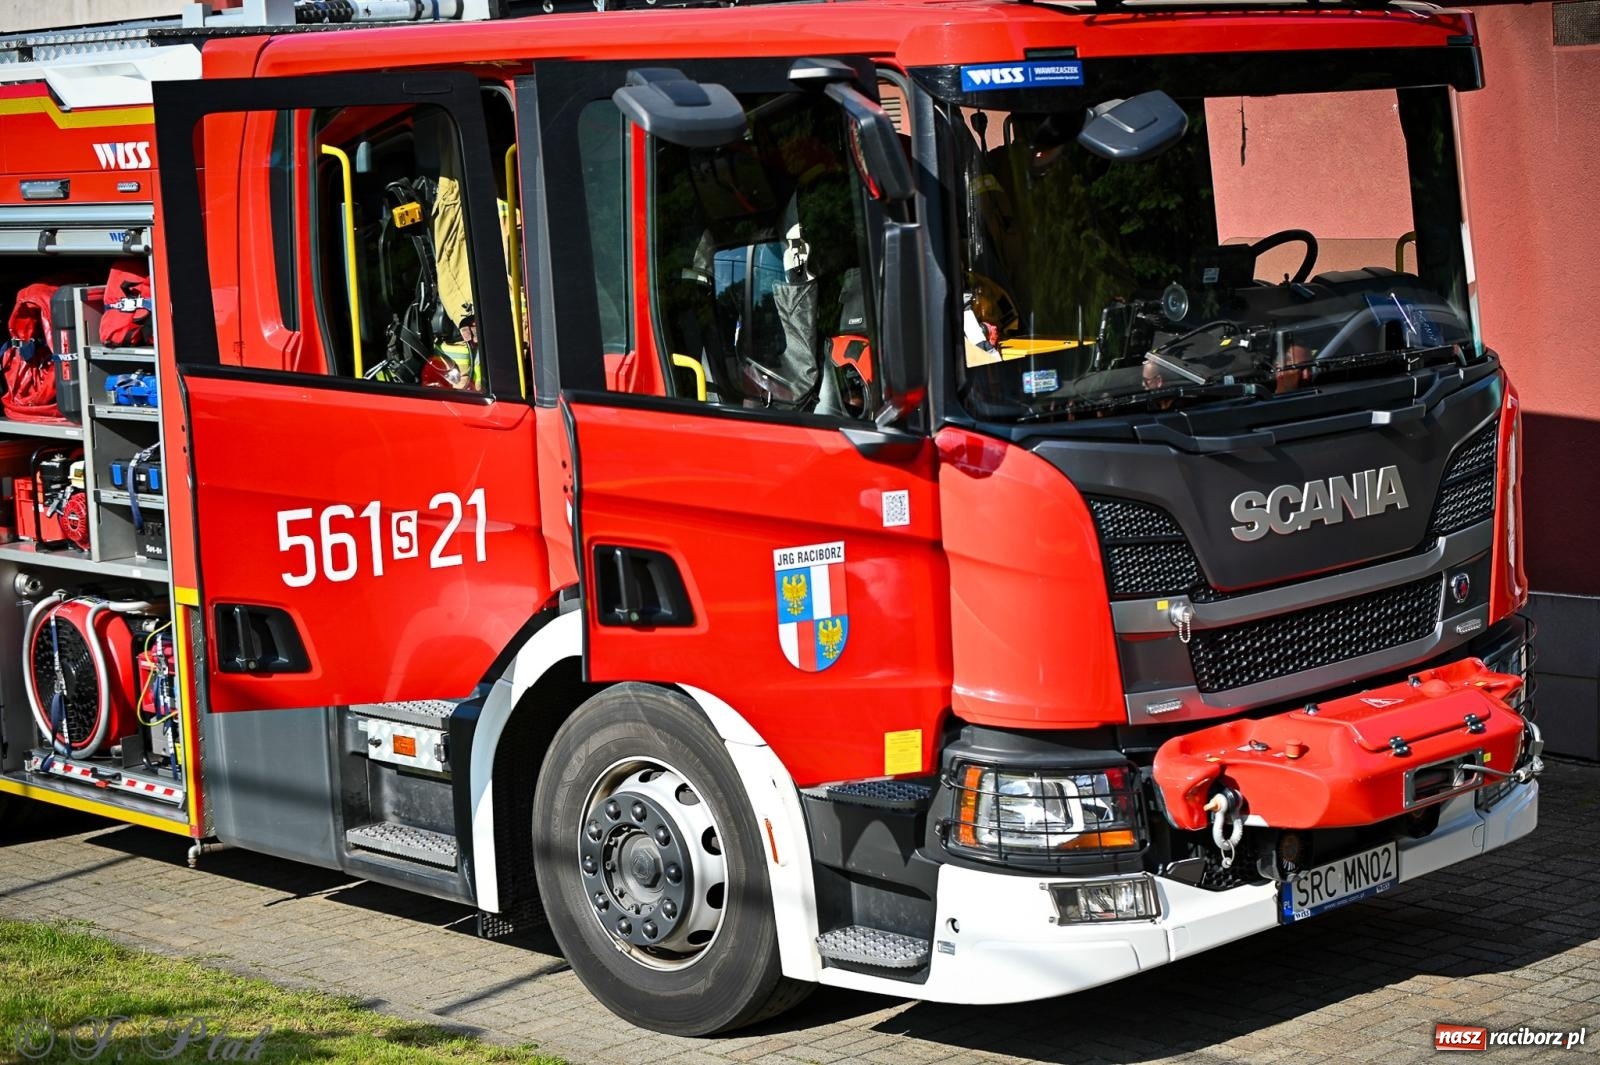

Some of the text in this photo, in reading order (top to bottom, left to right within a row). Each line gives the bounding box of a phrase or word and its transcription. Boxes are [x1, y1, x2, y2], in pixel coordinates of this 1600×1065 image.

[967, 67, 1025, 85] WISS
[92, 141, 151, 170] WISS
[1230, 465, 1409, 541] SCANIA
[277, 488, 487, 588] 561 S 21
[777, 552, 795, 566] JRG
[1297, 847, 1392, 907] SRC MN02
